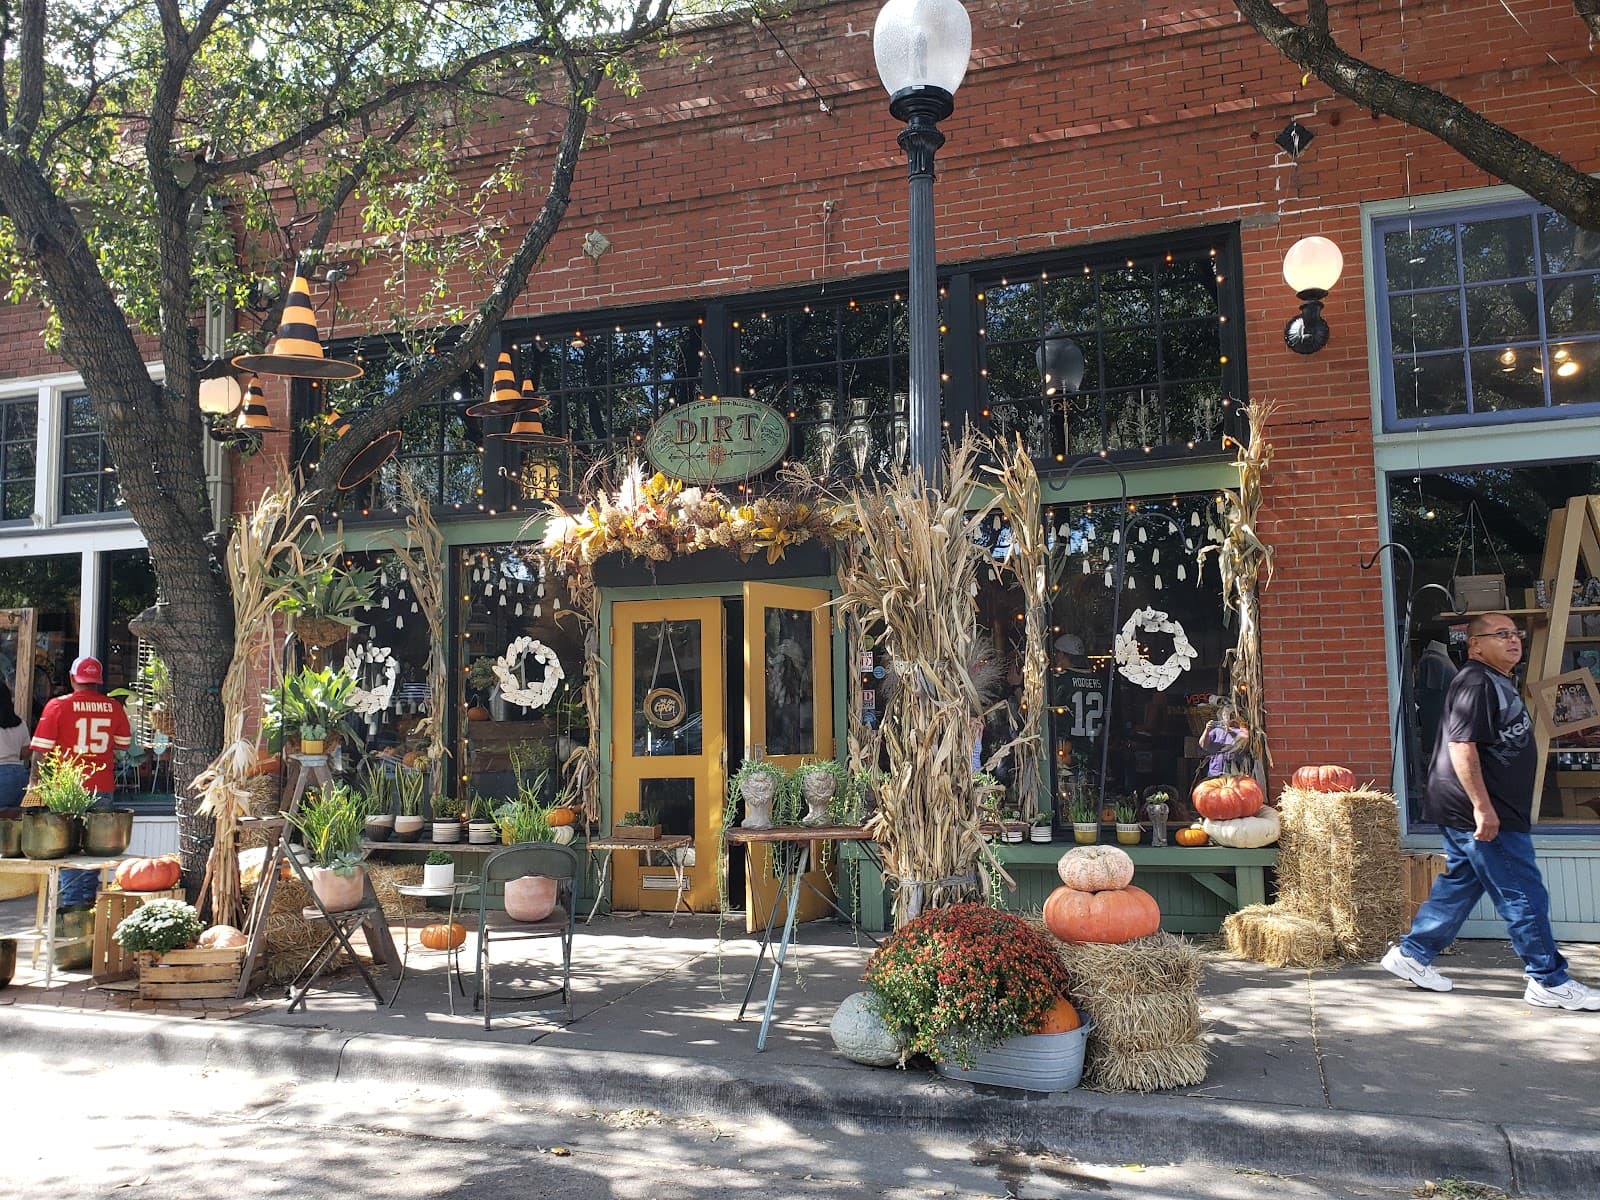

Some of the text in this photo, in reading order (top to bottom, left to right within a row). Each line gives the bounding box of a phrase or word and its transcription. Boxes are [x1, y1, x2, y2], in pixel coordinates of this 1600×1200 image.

[673, 413, 760, 444] DIRT
[1072, 677, 1102, 689] RODGERS
[73, 701, 113, 713] MAHOMES
[1071, 691, 1103, 737] 12
[73, 717, 111, 754] 15
